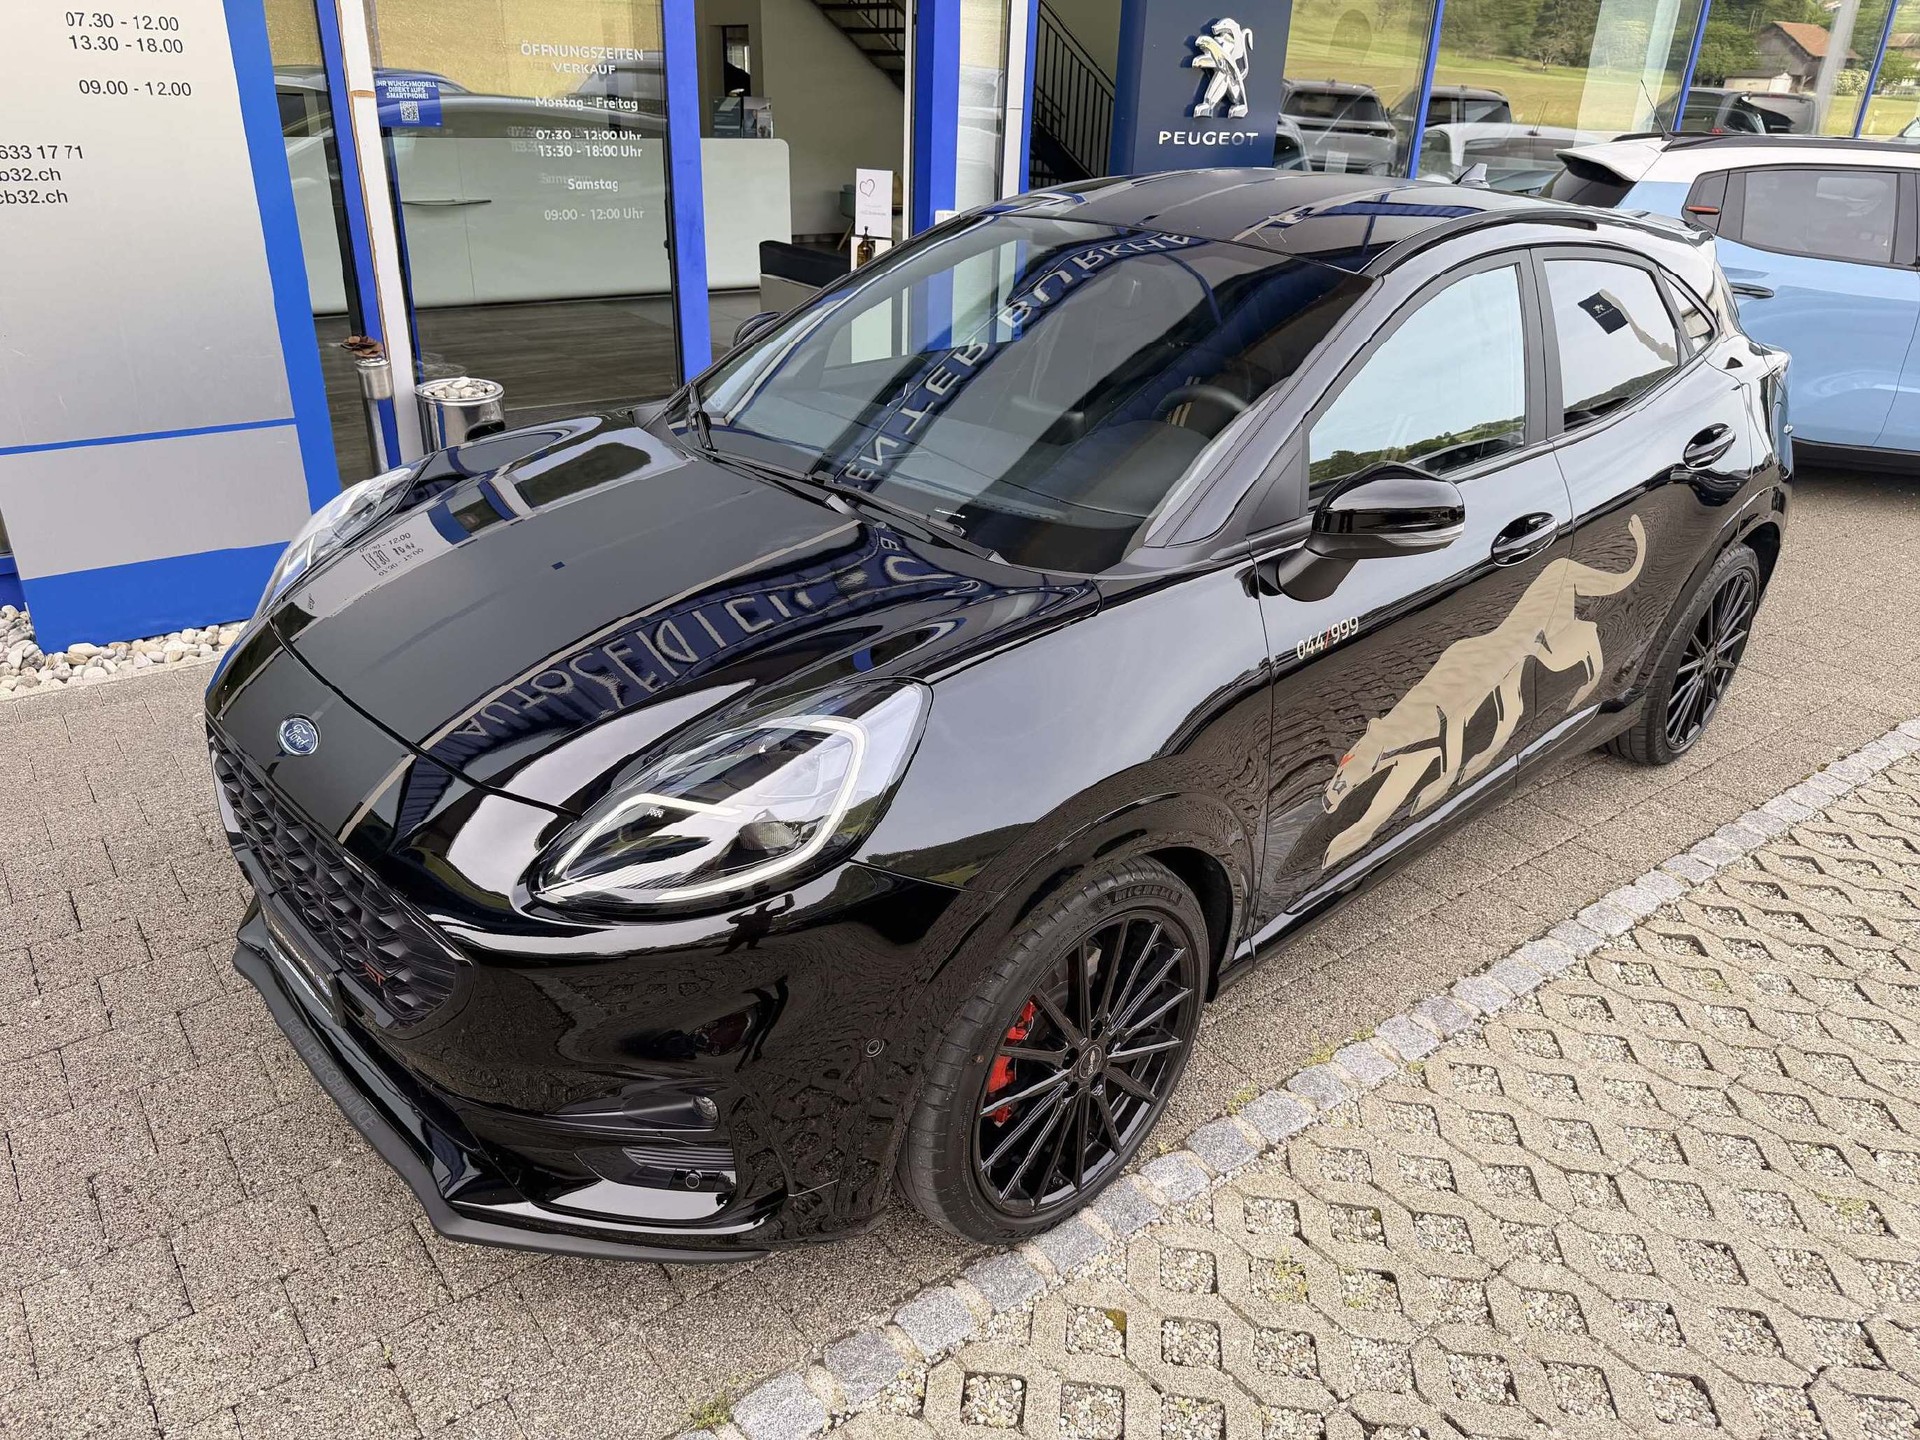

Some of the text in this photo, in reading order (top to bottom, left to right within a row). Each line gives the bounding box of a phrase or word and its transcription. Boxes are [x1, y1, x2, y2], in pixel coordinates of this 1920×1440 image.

[66, 11, 114, 28] 07.30
[133, 15, 179, 31] 12.00
[69, 35, 119, 51] 13.30
[137, 38, 183, 53] 18.00
[520, 40, 644, 61] ÖFFNUNGSZEITEN
[553, 62, 616, 75] VERKAUF
[79, 80, 128, 95] 09.00
[145, 82, 191, 96] 12.00
[535, 96, 584, 111] Montag
[596, 97, 638, 112] Freitag
[536, 129, 572, 141] 07:30
[584, 130, 617, 141] 12:00
[619, 130, 642, 141] Uhr
[1158, 131, 1258, 146] PEUGEOT
[0, 145, 83, 160] 633 17 71
[538, 145, 573, 158] 13:30
[586, 145, 618, 158] 18:00
[620, 145, 643, 158] Uhr
[567, 178, 619, 192] Samstag
[544, 209, 578, 221] 09:00
[590, 209, 620, 221] 12:00
[623, 208, 645, 220] Uhr
[1297, 616, 1359, 660] 044/999
[285, 723, 310, 749] Ford
